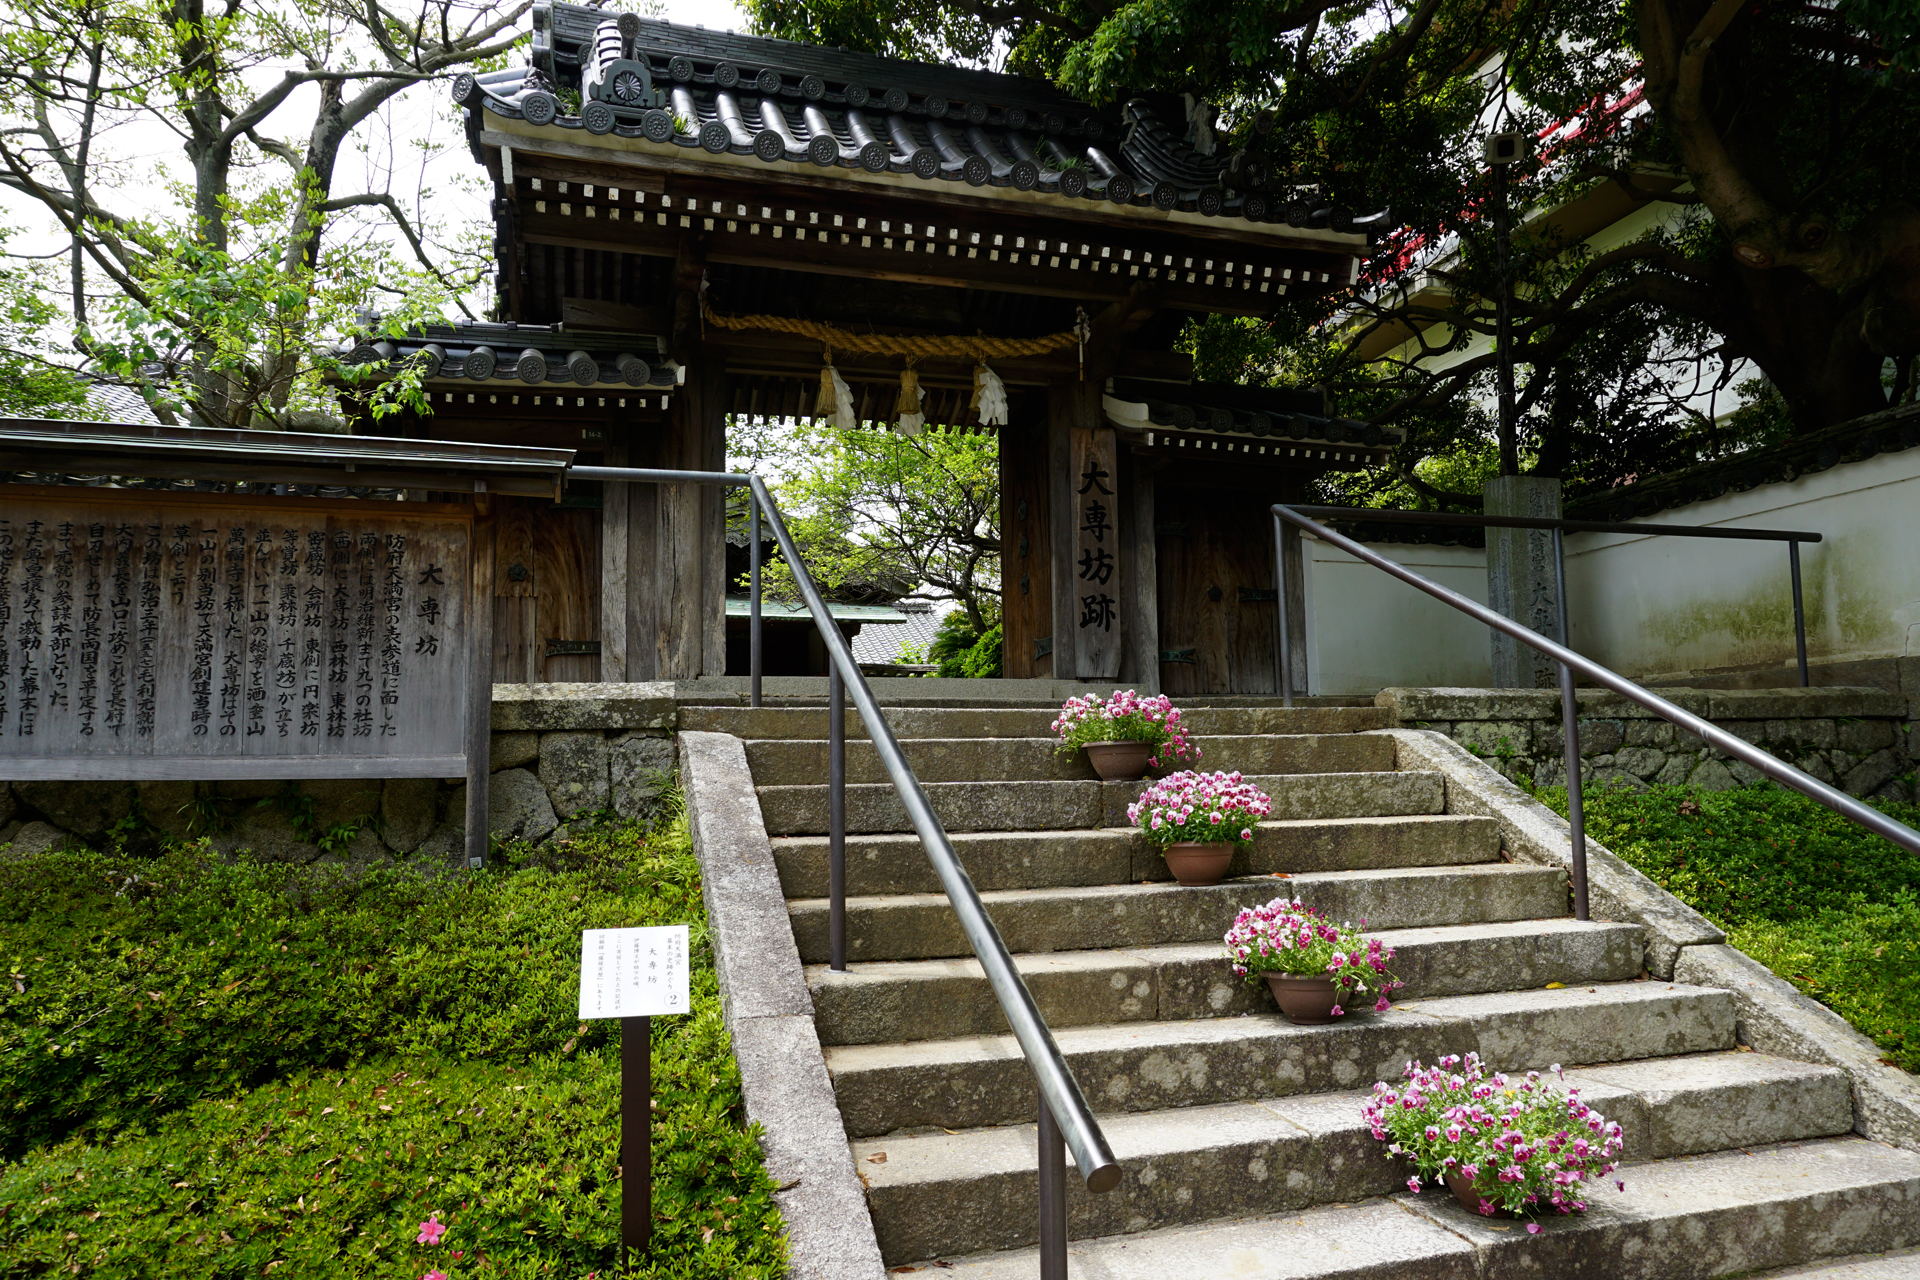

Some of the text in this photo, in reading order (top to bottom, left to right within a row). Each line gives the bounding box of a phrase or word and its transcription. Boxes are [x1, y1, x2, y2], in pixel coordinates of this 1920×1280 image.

[79, 523, 105, 736] 自刃せしめて防長両国を平定する
[104, 523, 134, 737] 大内義長を山口に攻めこれを長府で
[169, 524, 190, 605] 草創と云う
[190, 529, 217, 736] 一山の別当坊で天満宮創建当時の
[352, 532, 377, 737] 両側には明治維新まで九つの社坊
[380, 534, 405, 737] 防府天満宮の表参道に面した
[415, 563, 444, 657] 大専坊
[1076, 461, 1116, 633] 大専坊跡
[647, 947, 658, 984] 大専坊
